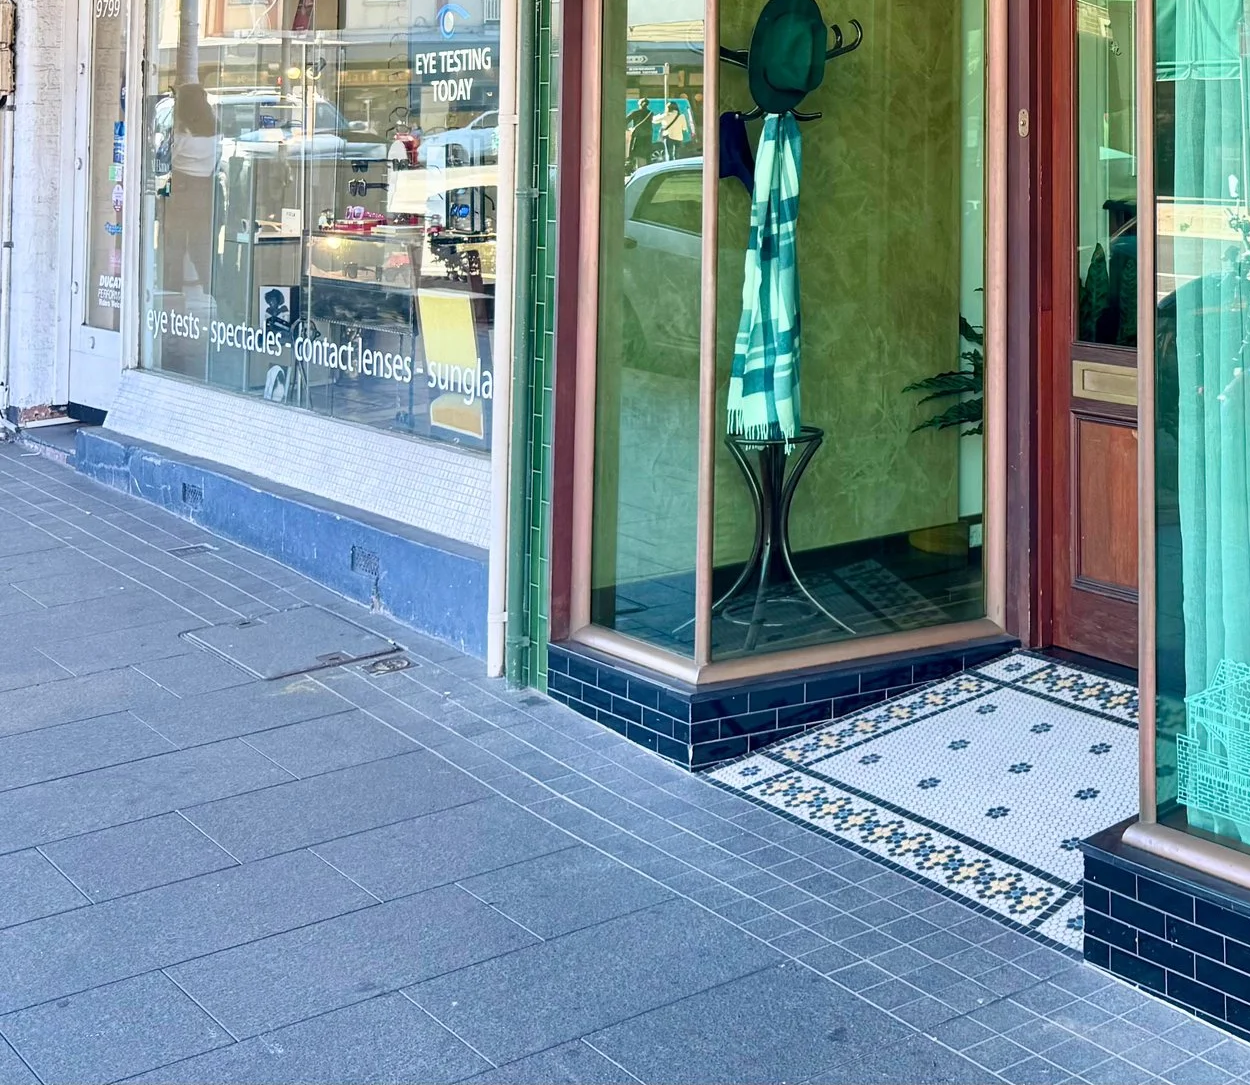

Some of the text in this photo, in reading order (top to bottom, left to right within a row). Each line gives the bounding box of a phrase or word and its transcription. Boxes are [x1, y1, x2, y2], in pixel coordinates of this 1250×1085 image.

[415, 47, 492, 75] EYE TESTING
[431, 77, 474, 102] TODAY
[146, 309, 169, 339] eye
[170, 310, 200, 340] tests
[210, 320, 282, 357] spectacles
[294, 336, 354, 373] contact
[357, 337, 412, 383] lenses
